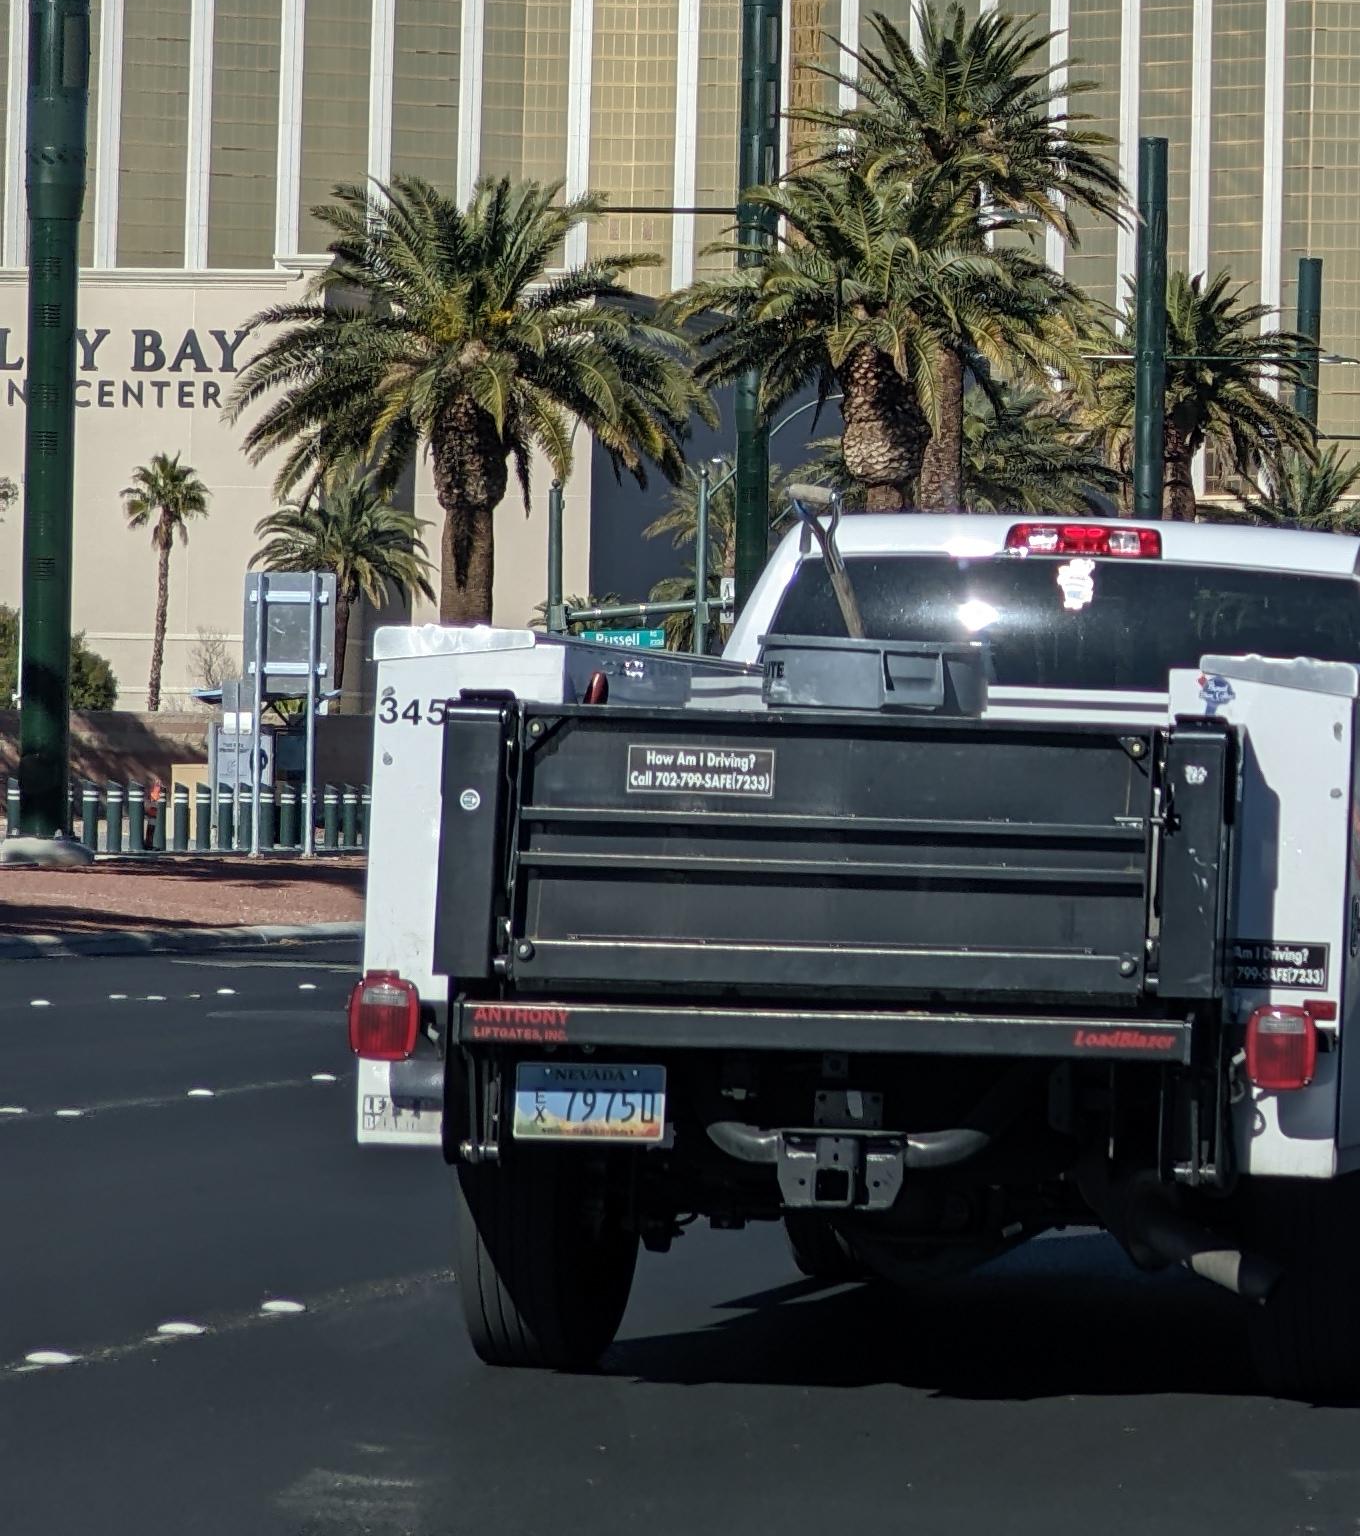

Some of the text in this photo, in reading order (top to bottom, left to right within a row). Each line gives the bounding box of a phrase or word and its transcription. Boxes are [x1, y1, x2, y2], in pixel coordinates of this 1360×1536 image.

[131, 329, 249, 372] BAY
[74, 380, 222, 408] CENTER
[379, 696, 445, 726] 345
[646, 750, 756, 772] How Am I Driving?
[630, 770, 769, 792] Call 702-799-SAFE(7233)
[1263, 946, 1310, 967] Driving?
[473, 1008, 568, 1024] ANTHONY
[1073, 1030, 1176, 1050] LoadBlazer
[555, 1068, 625, 1081] NEVADA
